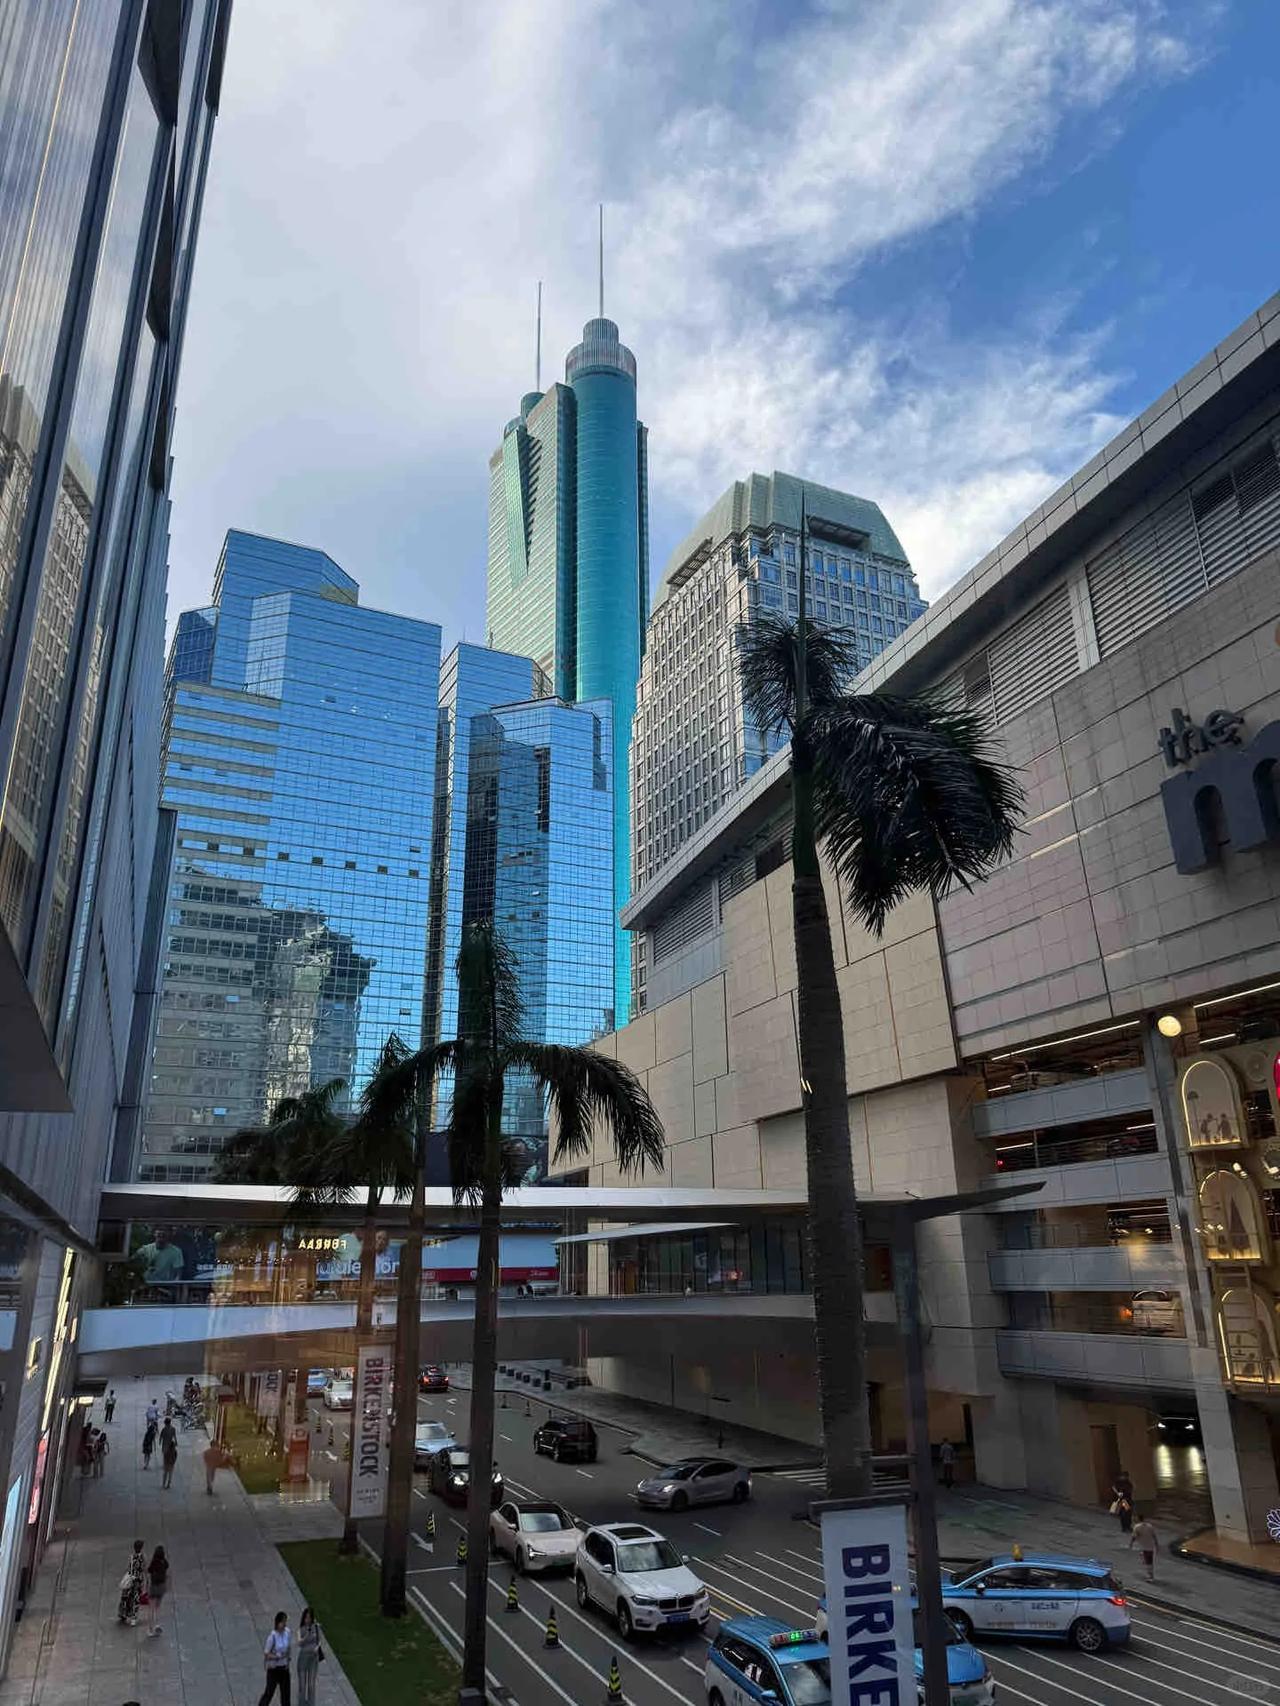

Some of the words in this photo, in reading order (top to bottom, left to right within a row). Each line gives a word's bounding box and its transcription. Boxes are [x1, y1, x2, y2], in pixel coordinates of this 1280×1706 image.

[1158, 708, 1244, 768] the
[358, 1357, 384, 1478] BIRKENSTOCK
[842, 1543, 900, 1706] BIRKE
